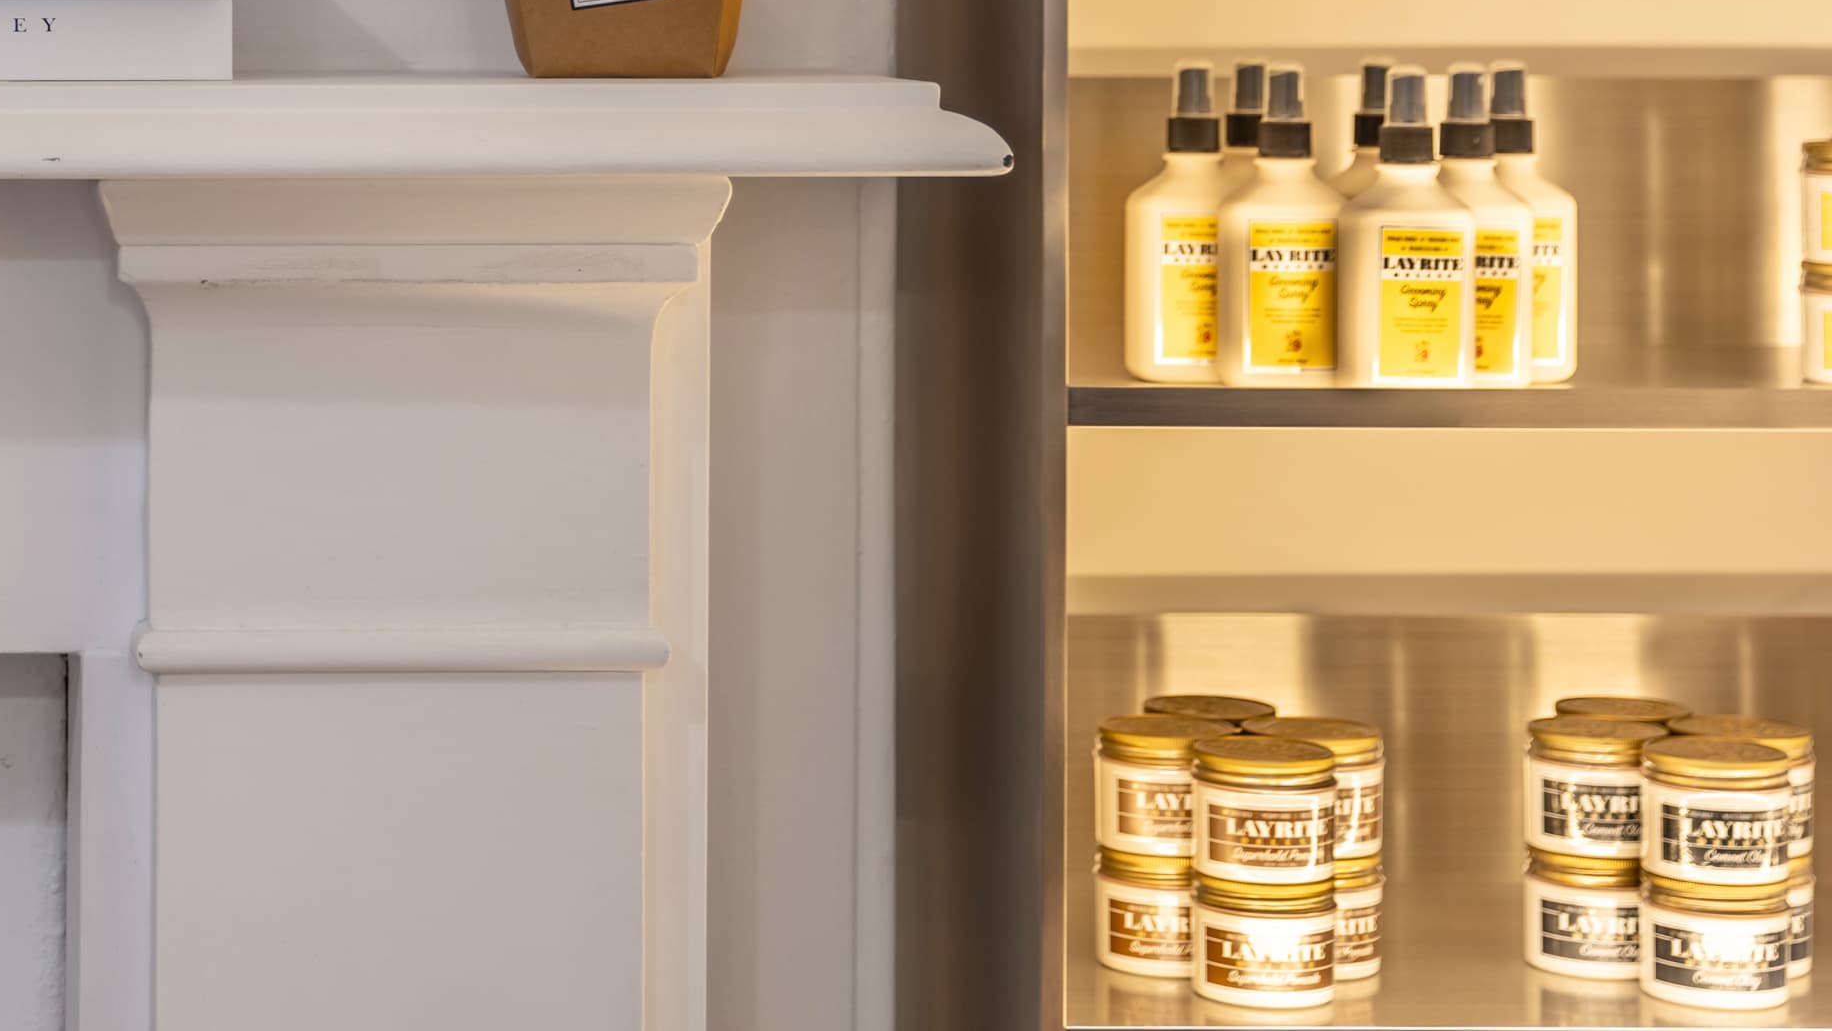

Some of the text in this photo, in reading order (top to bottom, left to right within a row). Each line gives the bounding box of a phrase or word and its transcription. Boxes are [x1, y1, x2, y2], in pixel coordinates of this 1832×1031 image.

[1251, 249, 1336, 263] LAYRITE
[1475, 255, 1520, 270] RITE
[1383, 257, 1464, 271] LAYRITE
[1226, 817, 1329, 839] LAYRITE
